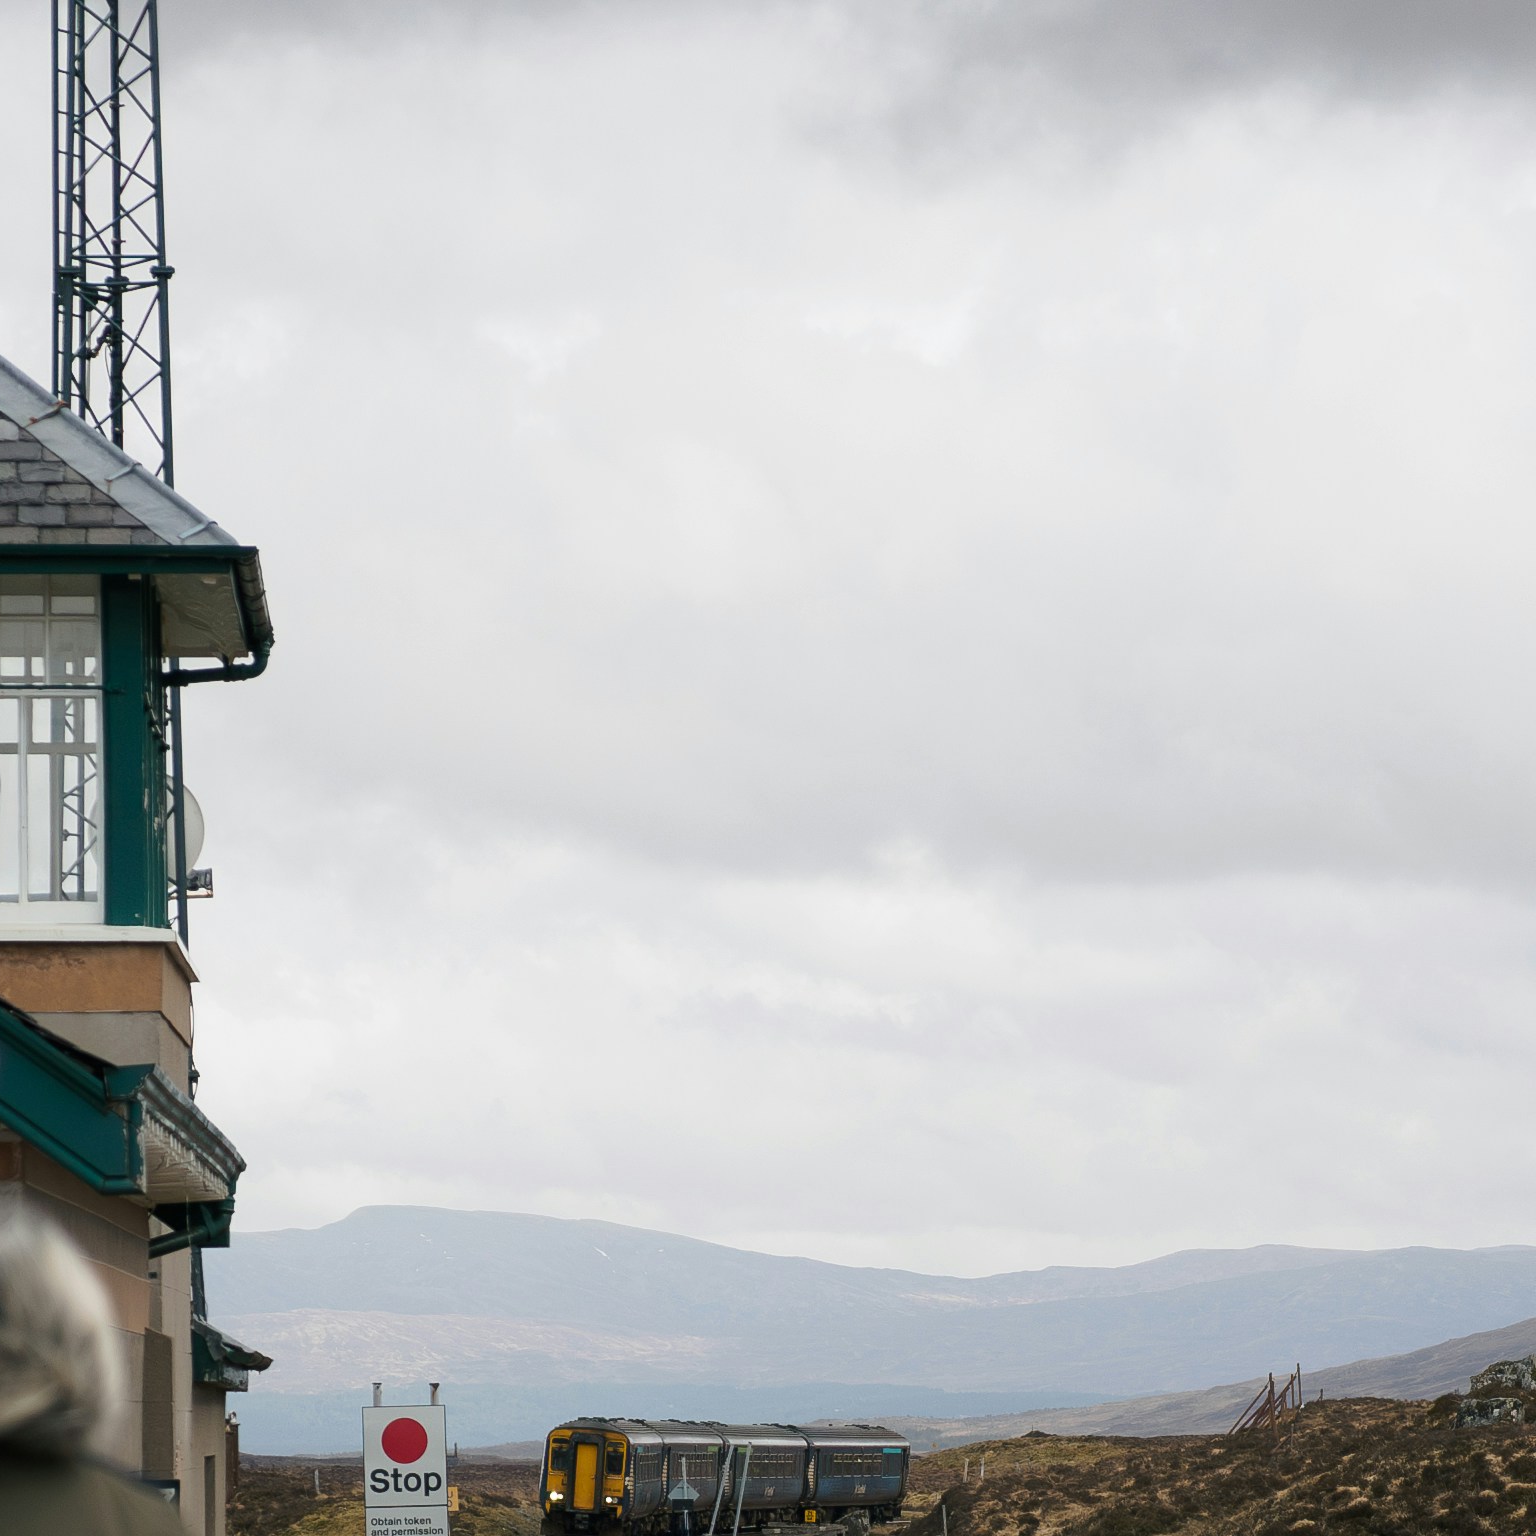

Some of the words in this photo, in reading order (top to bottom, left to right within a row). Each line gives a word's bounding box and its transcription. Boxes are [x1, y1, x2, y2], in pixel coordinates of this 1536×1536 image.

[370, 1468, 442, 1496] Stop
[370, 1517, 402, 1526] Obtain
[404, 1516, 432, 1525] token
[371, 1528, 389, 1536] and
[391, 1527, 444, 1536] permission
